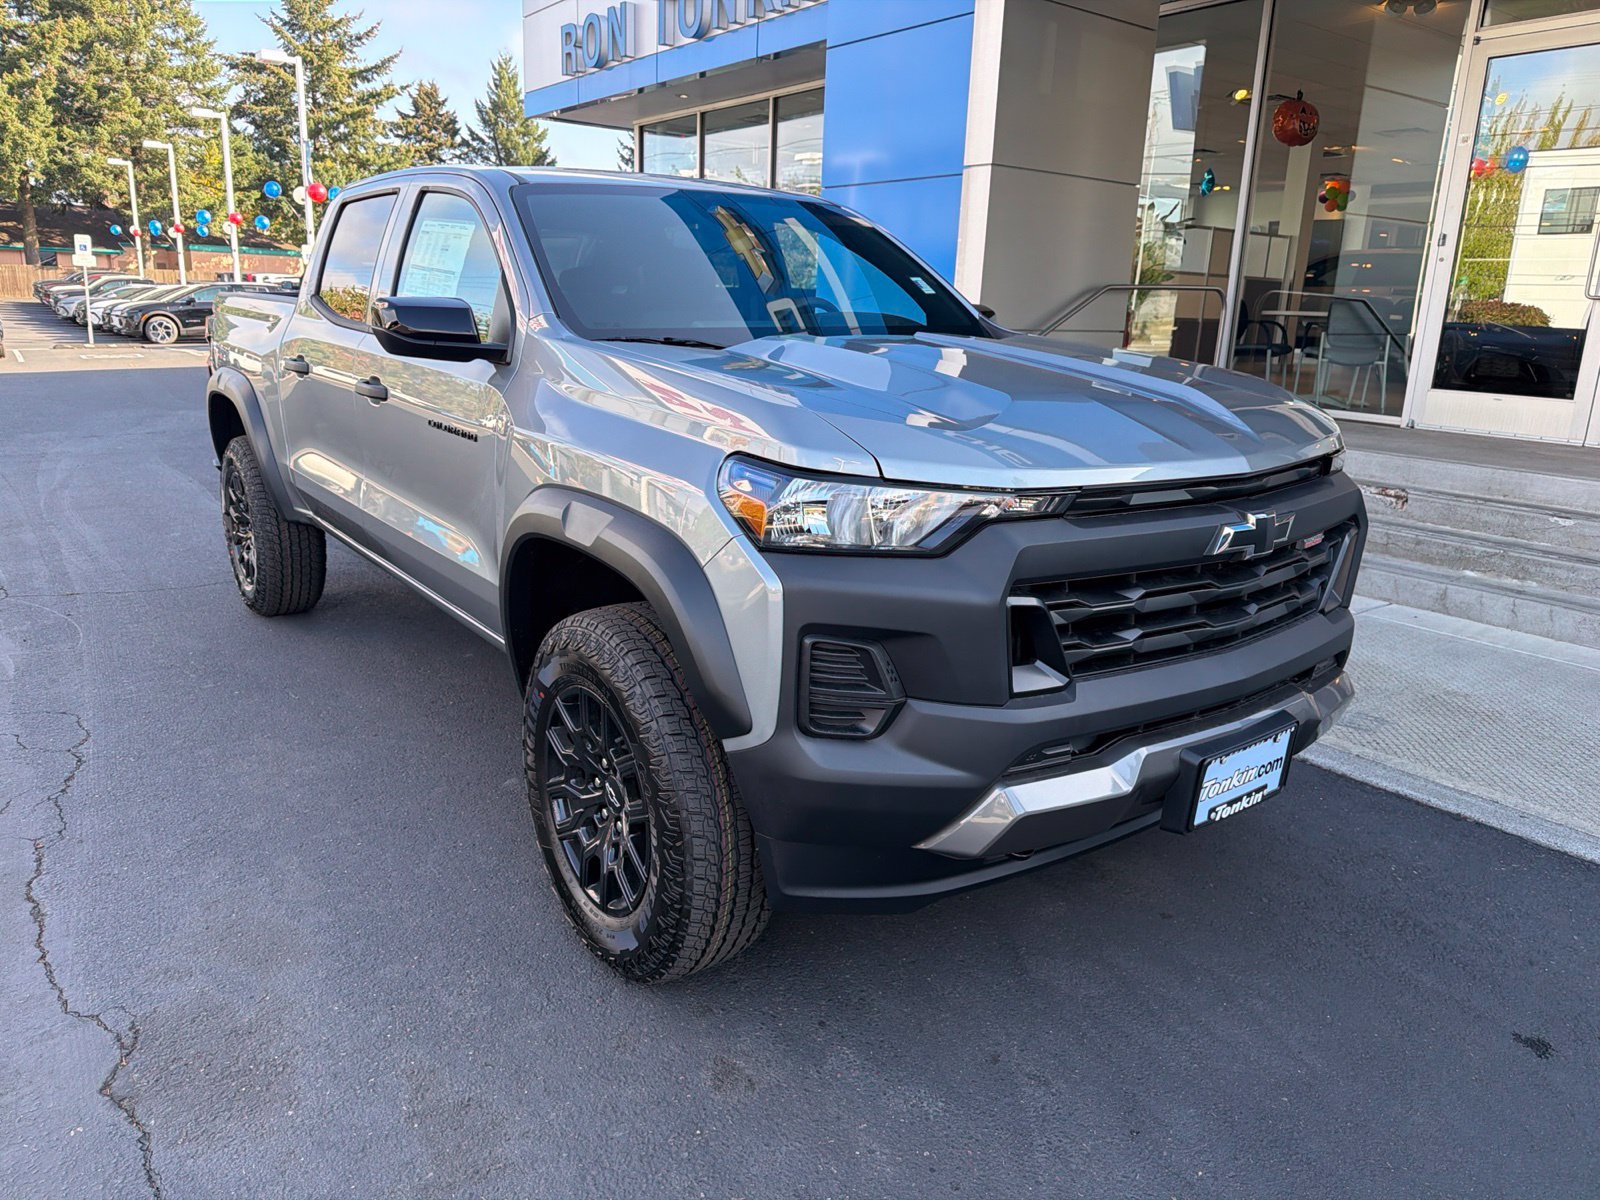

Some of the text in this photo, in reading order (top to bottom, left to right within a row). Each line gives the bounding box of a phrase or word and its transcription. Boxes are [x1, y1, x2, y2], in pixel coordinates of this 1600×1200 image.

[561, 1, 634, 76] RON
[1199, 756, 1284, 803] Tonkin.com
[1214, 791, 1263, 822] Tonkin
